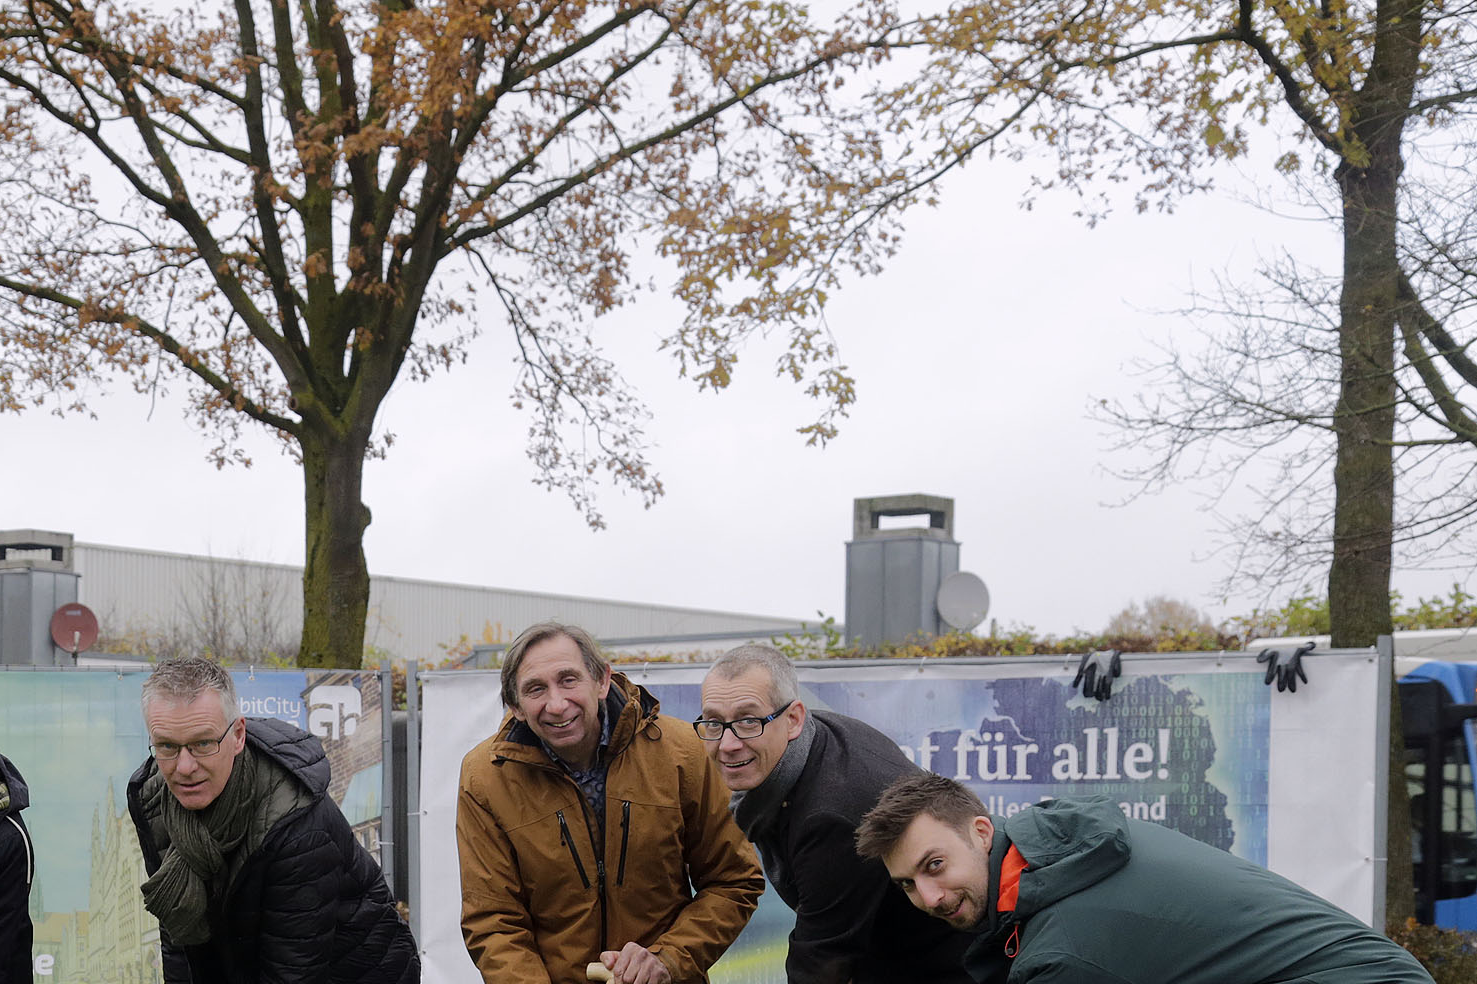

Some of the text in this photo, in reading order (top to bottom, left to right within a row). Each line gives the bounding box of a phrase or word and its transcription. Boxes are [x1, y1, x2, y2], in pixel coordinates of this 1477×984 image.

[238, 697, 300, 719] bitCity
[952, 729, 1039, 781] für
[1052, 727, 1171, 781] alle!
